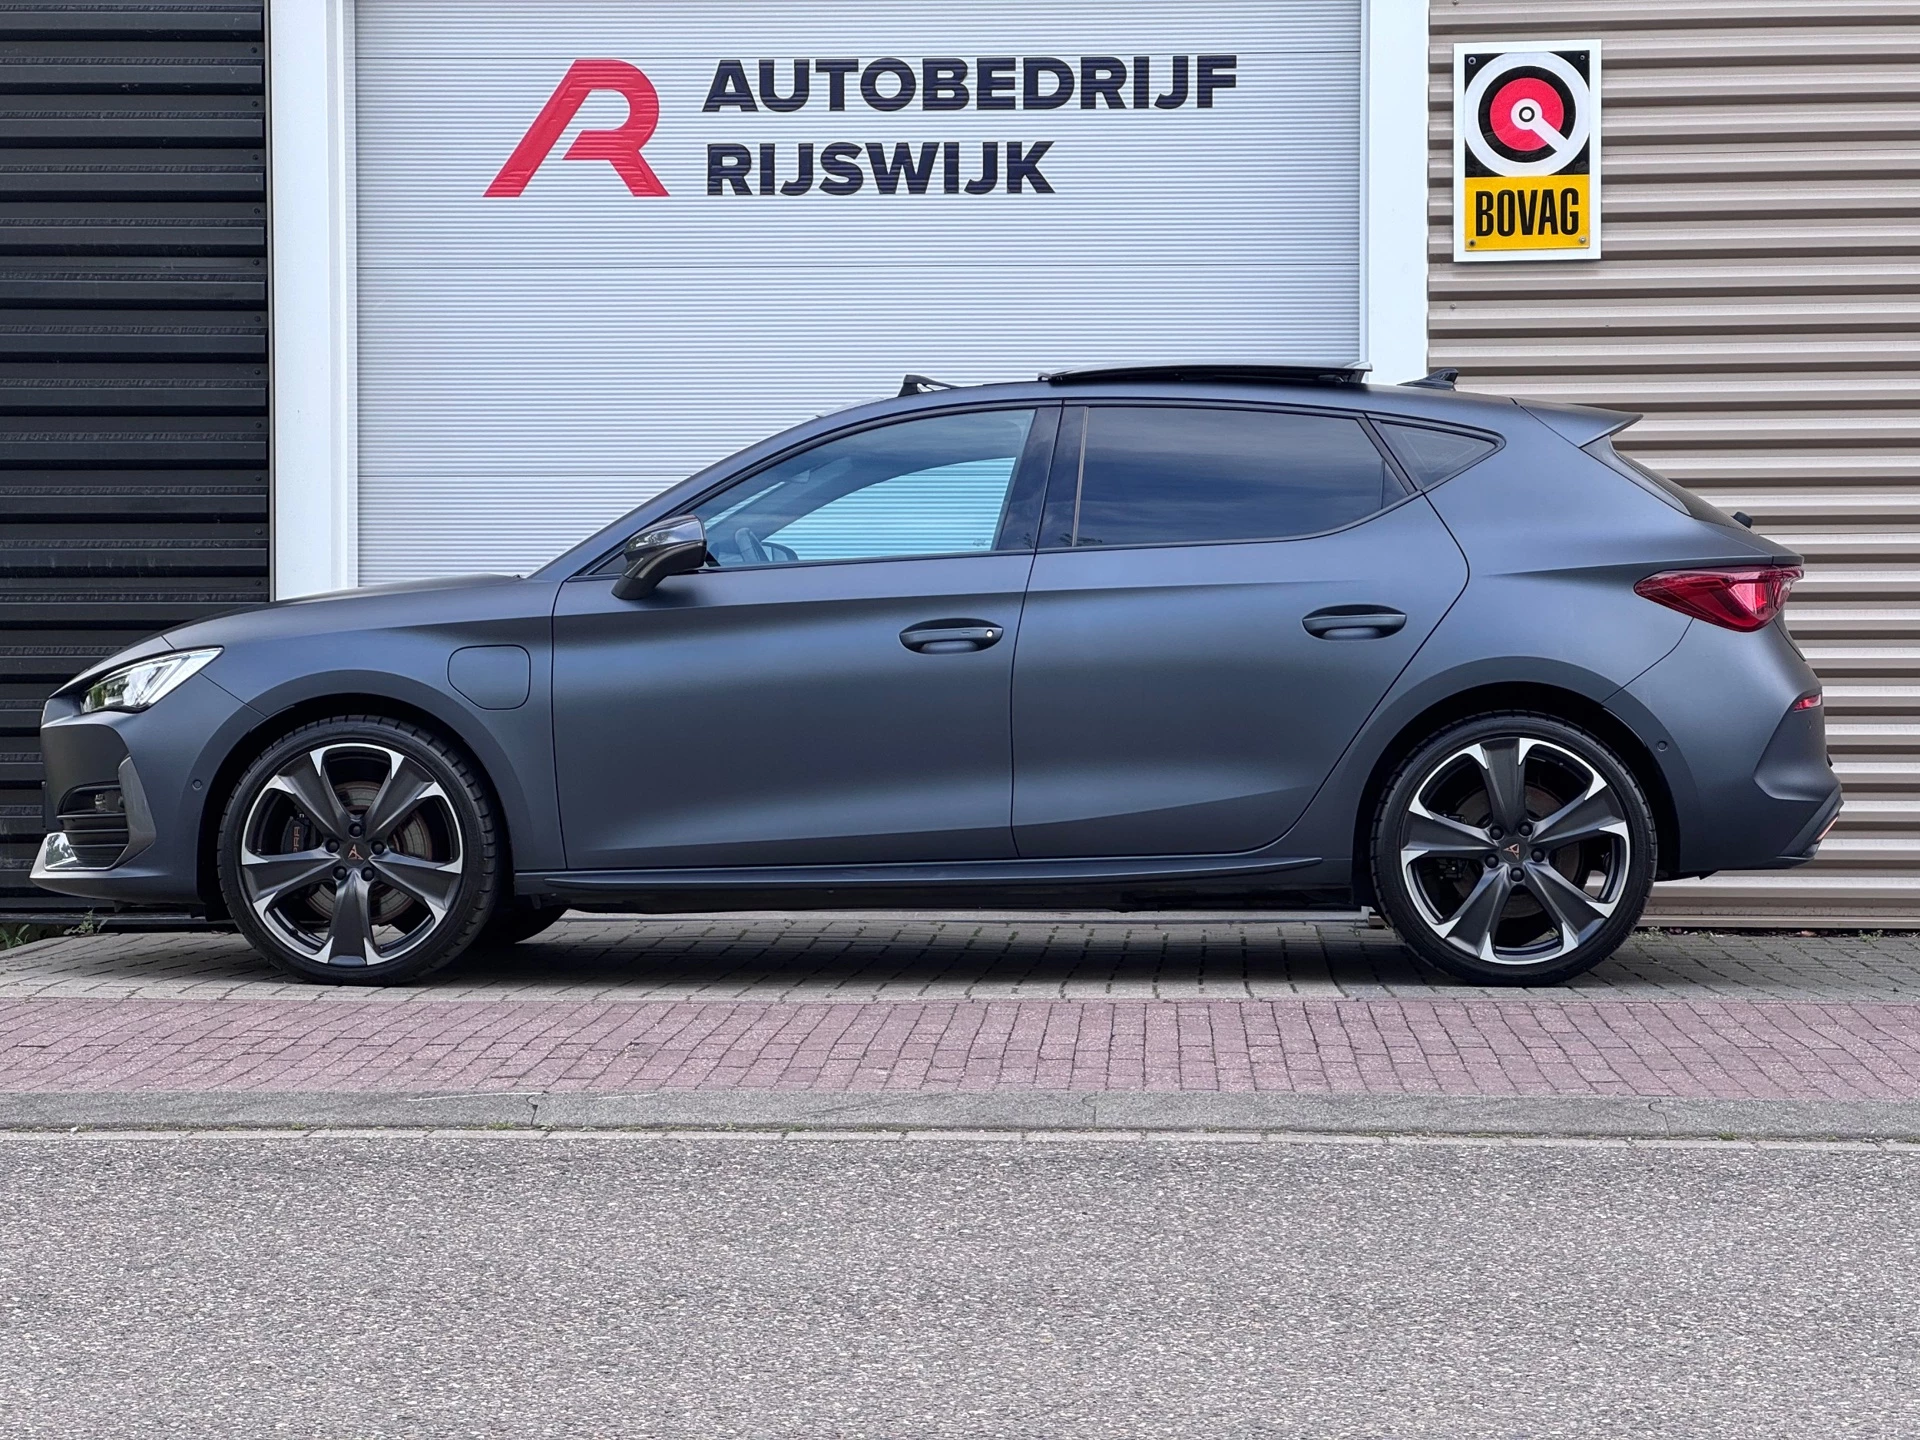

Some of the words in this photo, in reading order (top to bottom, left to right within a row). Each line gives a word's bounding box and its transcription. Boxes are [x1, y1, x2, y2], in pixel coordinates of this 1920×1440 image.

[701, 54, 1237, 113] AUTOBEDRIJF
[707, 140, 1056, 197] RIJSWIJK
[1475, 187, 1579, 237] BOVAG
